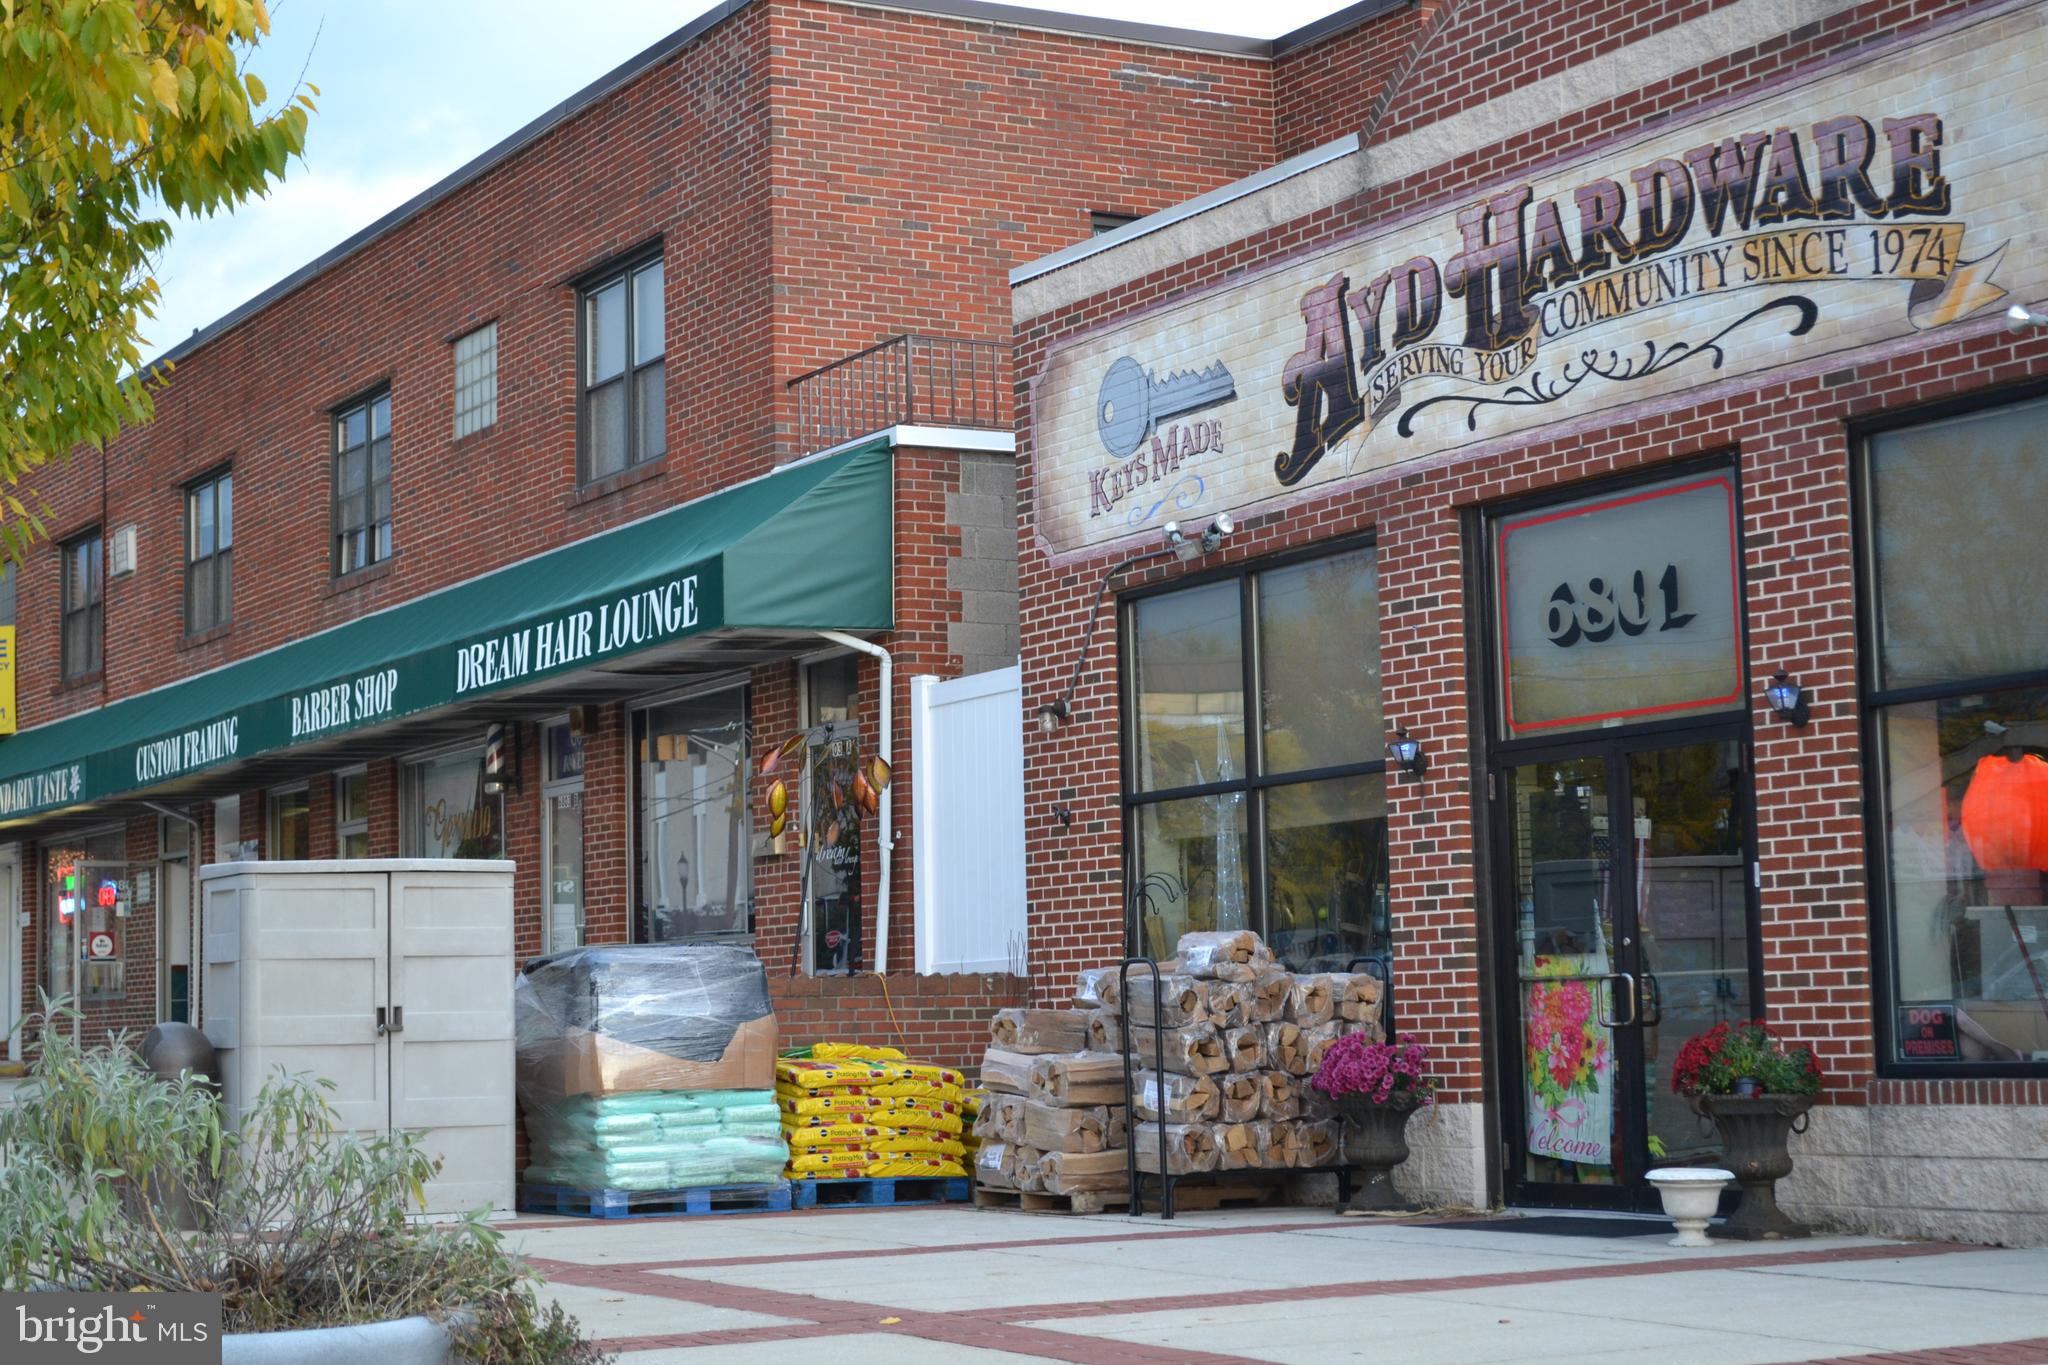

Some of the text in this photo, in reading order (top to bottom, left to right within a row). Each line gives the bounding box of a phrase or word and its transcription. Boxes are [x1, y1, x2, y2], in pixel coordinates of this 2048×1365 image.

[1274, 112, 1951, 487] AYD HARDWARE
[1371, 225, 1951, 405] SERVING YOUR COMMUNITY SINCE 1974
[1088, 417, 1224, 518] KEYS MADE
[456, 574, 699, 694] DREAM HAIR LOUNGE
[1541, 562, 1700, 648] 6801
[291, 668, 398, 737] BARBER SHOP
[37, 767, 69, 806] TASTE
[136, 716, 240, 782] CUSTOM FRAMING
[1905, 1039, 1955, 1056] PREMISES
[1909, 1009, 1943, 1025] DOG
